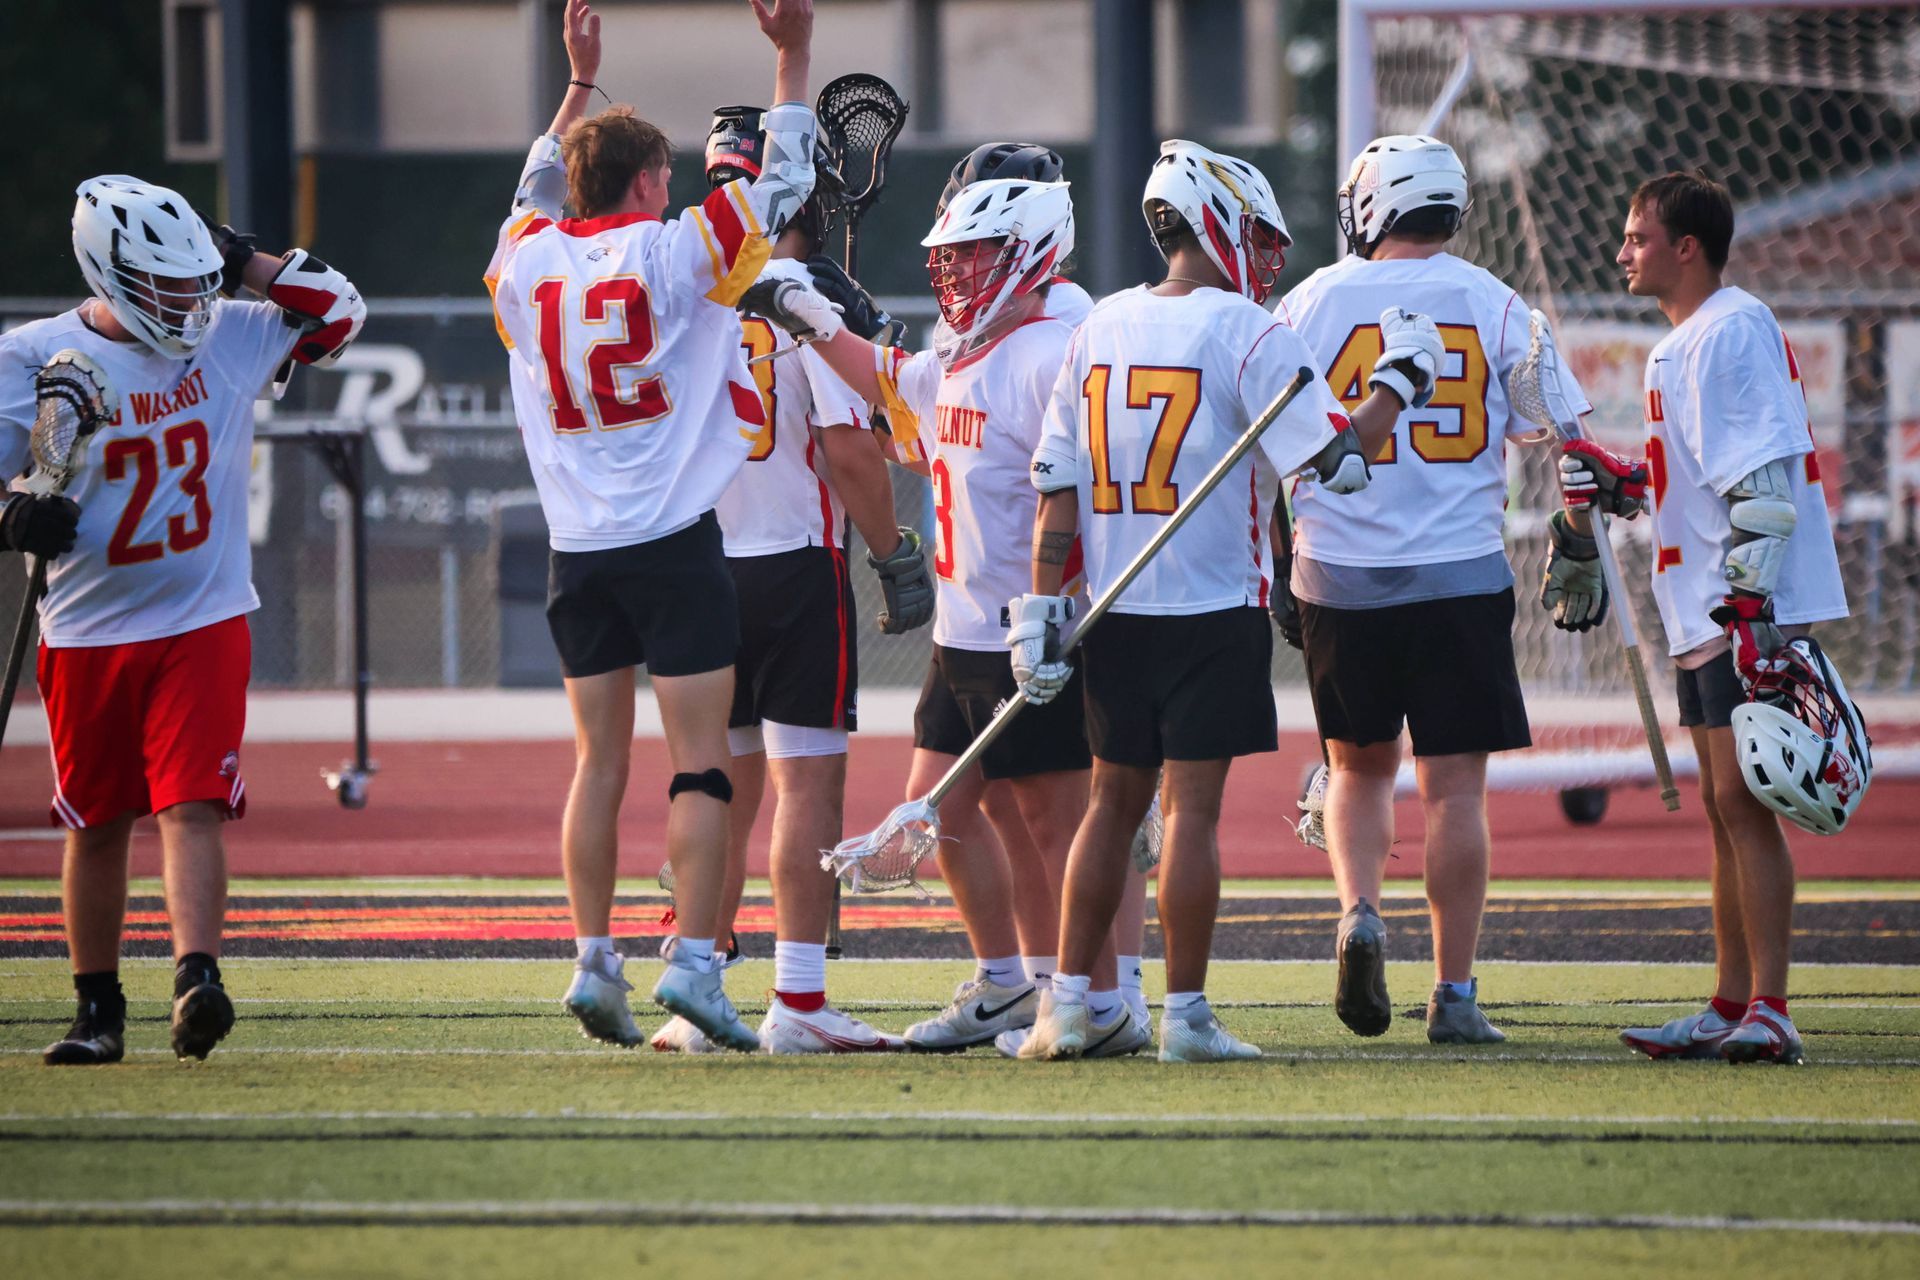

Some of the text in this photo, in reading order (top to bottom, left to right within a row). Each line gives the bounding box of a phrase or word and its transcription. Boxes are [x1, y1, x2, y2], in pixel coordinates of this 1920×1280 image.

[529, 272, 673, 435] 12
[104, 419, 213, 567] 23
[1082, 363, 1203, 516] 17
